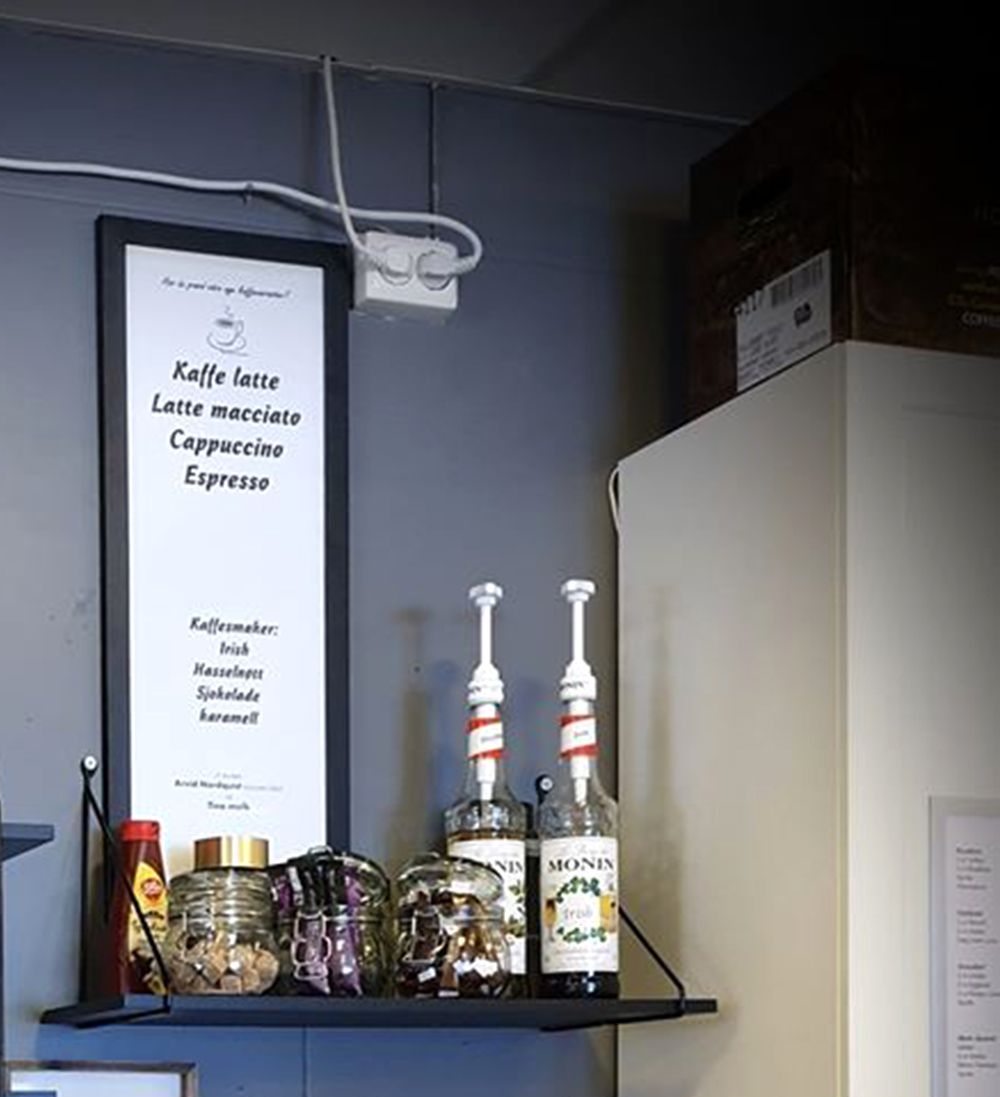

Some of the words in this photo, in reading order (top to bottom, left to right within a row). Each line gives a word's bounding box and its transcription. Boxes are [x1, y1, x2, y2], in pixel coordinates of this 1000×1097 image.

[172, 360, 226, 389] Kaffe
[233, 366, 280, 391] latte
[151, 393, 204, 417] Latte
[210, 405, 302, 426] macciato
[169, 429, 284, 458] Cappuccino
[184, 465, 270, 491] Espresso
[190, 617, 279, 636] Kaffesmaker:
[219, 641, 250, 657] Irish
[196, 685, 261, 703] Sjokolade
[548, 857, 614, 873] MONIN
